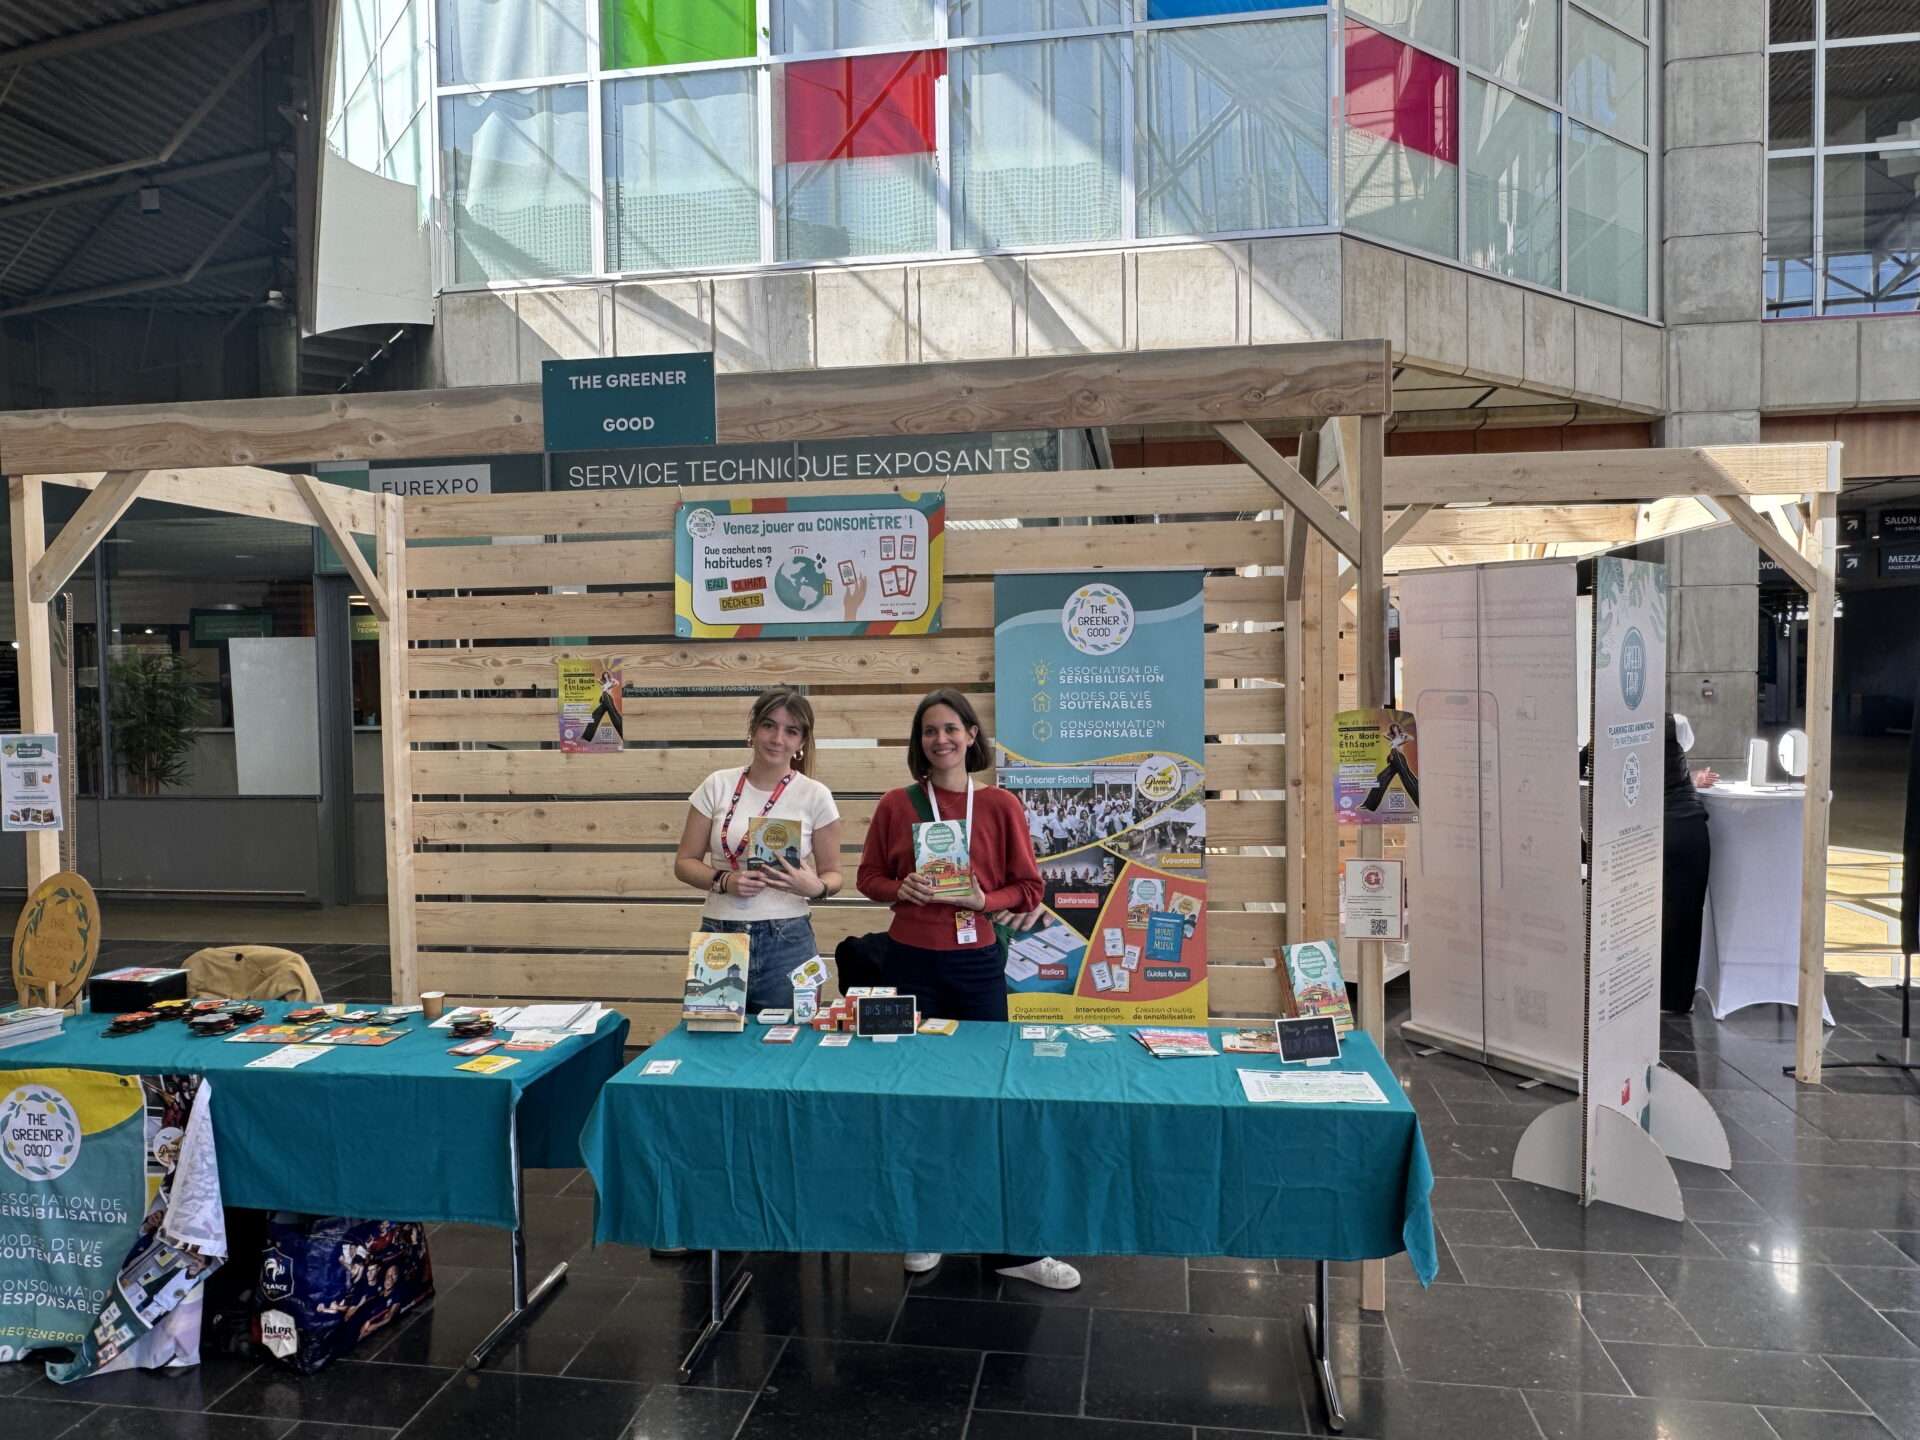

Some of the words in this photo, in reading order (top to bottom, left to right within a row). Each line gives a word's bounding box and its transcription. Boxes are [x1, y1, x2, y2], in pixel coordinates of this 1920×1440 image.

[569, 375, 603, 390] THE
[606, 371, 687, 387] GREENER
[603, 416, 655, 432] GOOD
[569, 463, 679, 488] SERVICE
[685, 454, 848, 483] TECHNIQUE
[856, 448, 1031, 475] EXPOSANTS
[382, 478, 479, 496] EUREXPO
[723, 520, 760, 535] Venez
[760, 519, 795, 537] jouer
[798, 520, 814, 532] au
[817, 513, 902, 532] CONSOMÈTRE
[704, 546, 720, 556] Que
[722, 545, 755, 555] cachent
[704, 556, 762, 569] habitudes
[1090, 605, 1108, 614] THE
[1078, 616, 1120, 626] GREENER
[1087, 628, 1111, 638] GOOD
[1060, 665, 1139, 675] ASSOCIATION
[1144, 665, 1161, 674] DE
[1060, 675, 1165, 684] SENSIBILISATION
[1060, 691, 1105, 701] MODES
[1110, 691, 1127, 700] DE
[1132, 690, 1151, 700] VIE
[1060, 700, 1153, 710] SOUTENABLES
[1060, 719, 1166, 730] CONSOMMATION
[1060, 729, 1154, 739] RESPONSABLE
[1009, 774, 1021, 784] The
[1023, 774, 1055, 784] Greener
[1057, 774, 1090, 784] Festival
[27, 1113, 48, 1126] THE
[13, 1129, 64, 1142] GREENER
[23, 1144, 52, 1158] GOOD
[101, 1198, 121, 1211] DE
[51, 1238, 75, 1252] DE
[80, 1240, 103, 1255] VIE
